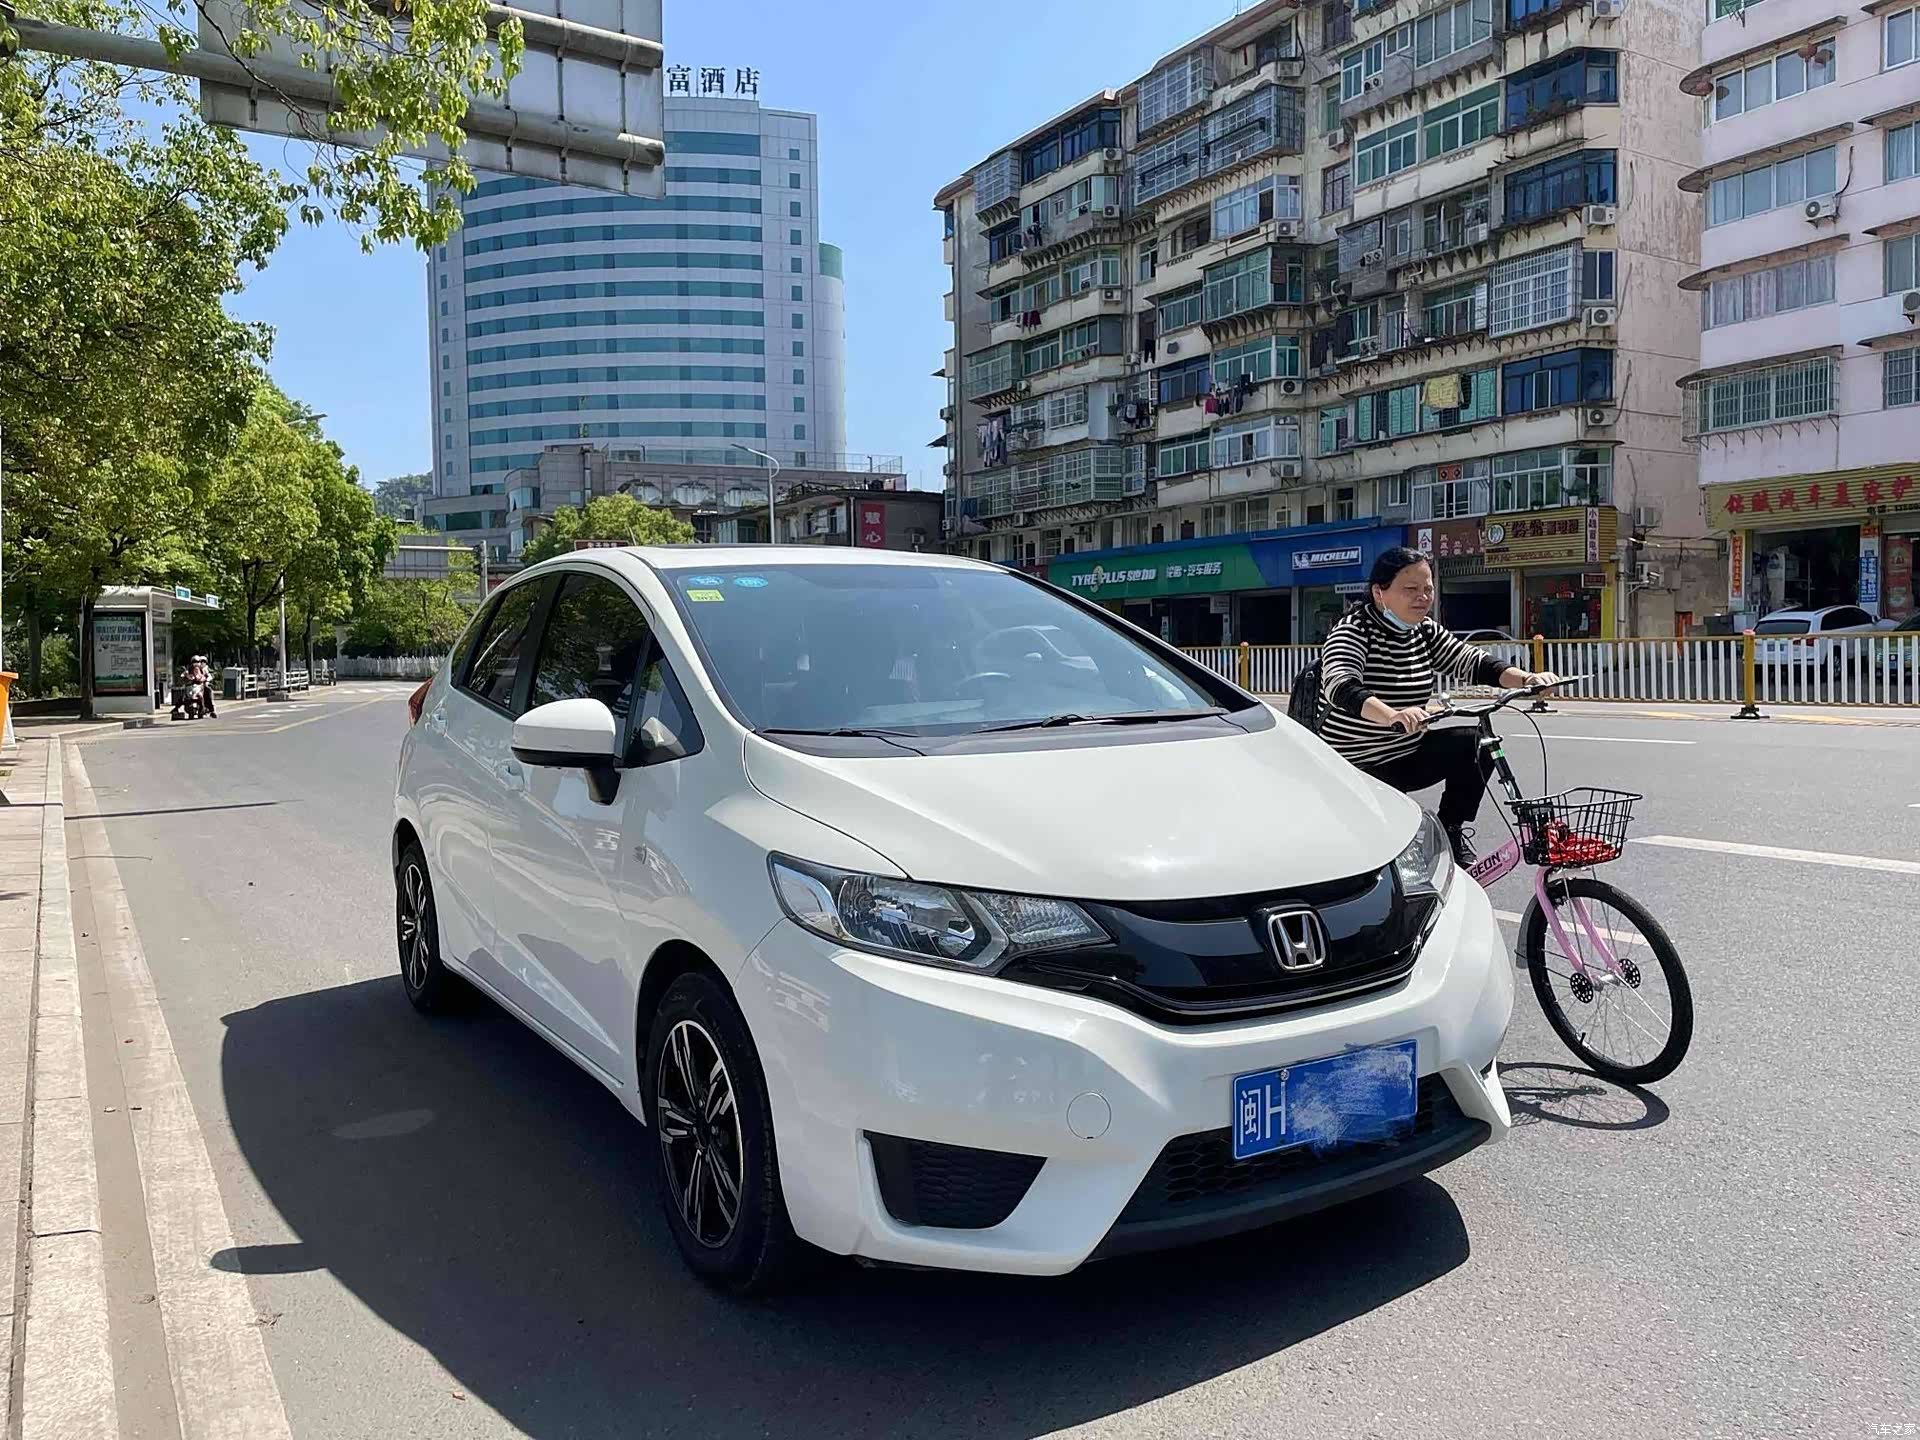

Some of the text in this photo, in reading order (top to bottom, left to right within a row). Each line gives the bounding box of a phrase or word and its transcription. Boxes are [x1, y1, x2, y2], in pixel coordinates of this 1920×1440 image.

[666, 64, 760, 95] 富酒店
[1311, 550, 1358, 563] MICHELIN
